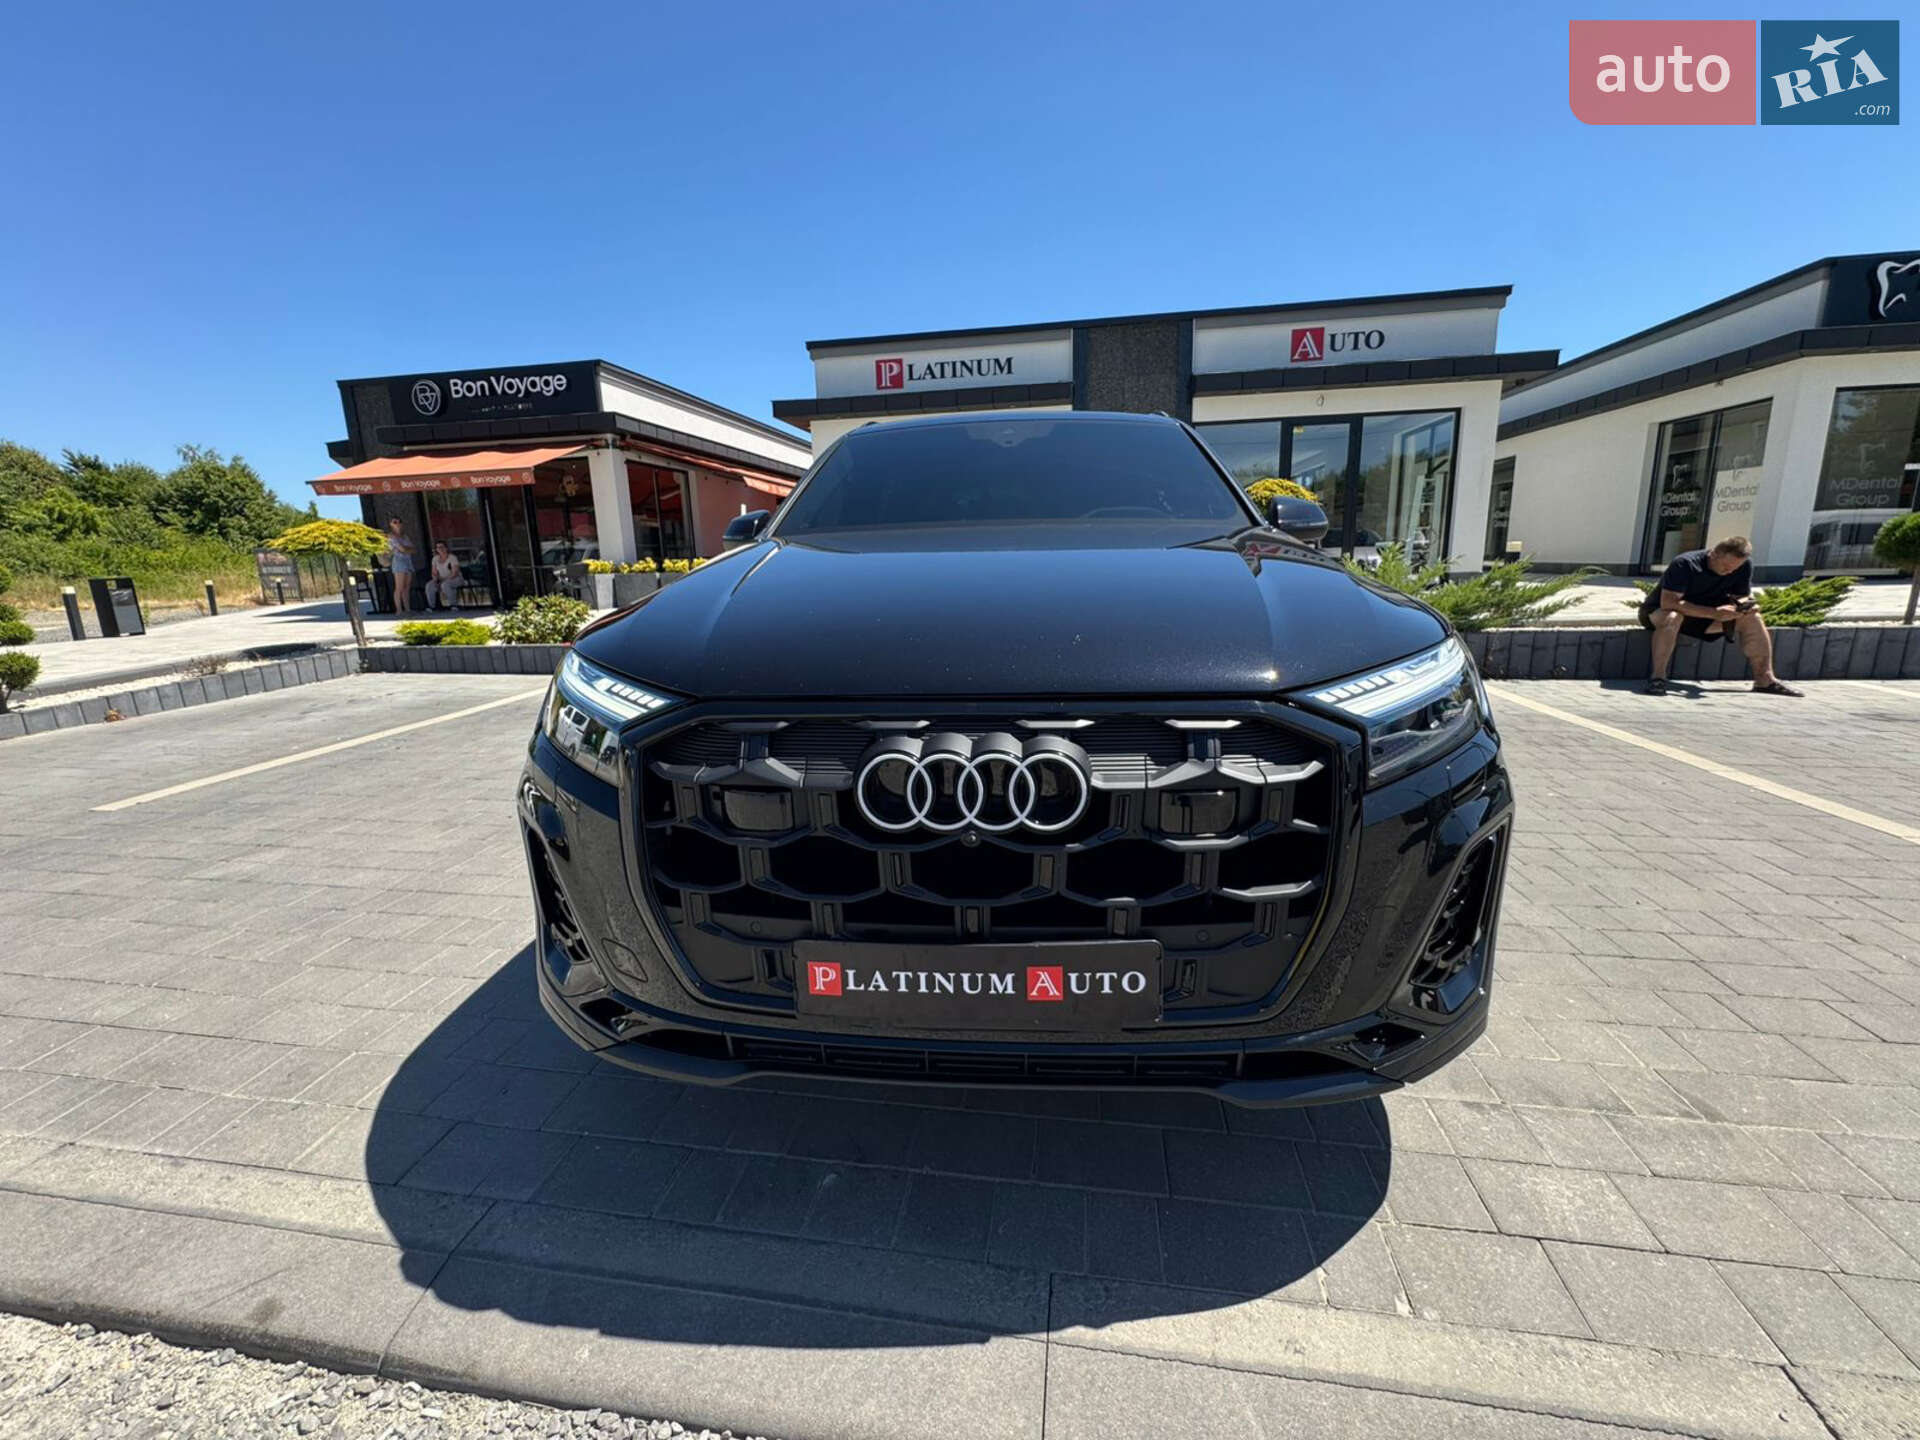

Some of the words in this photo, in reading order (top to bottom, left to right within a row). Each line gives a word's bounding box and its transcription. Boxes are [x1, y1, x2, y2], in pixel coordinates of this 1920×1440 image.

[1292, 329, 1385, 360] AUTO
[878, 356, 1015, 388] PLATINUM
[450, 378, 490, 399] Bon
[490, 374, 567, 398] Voyage
[1830, 475, 1904, 491] MDental
[1717, 501, 1752, 514] Group
[1836, 492, 1890, 507] Group
[813, 965, 1015, 995] PLATINUM
[1029, 970, 1147, 997] AUTO
